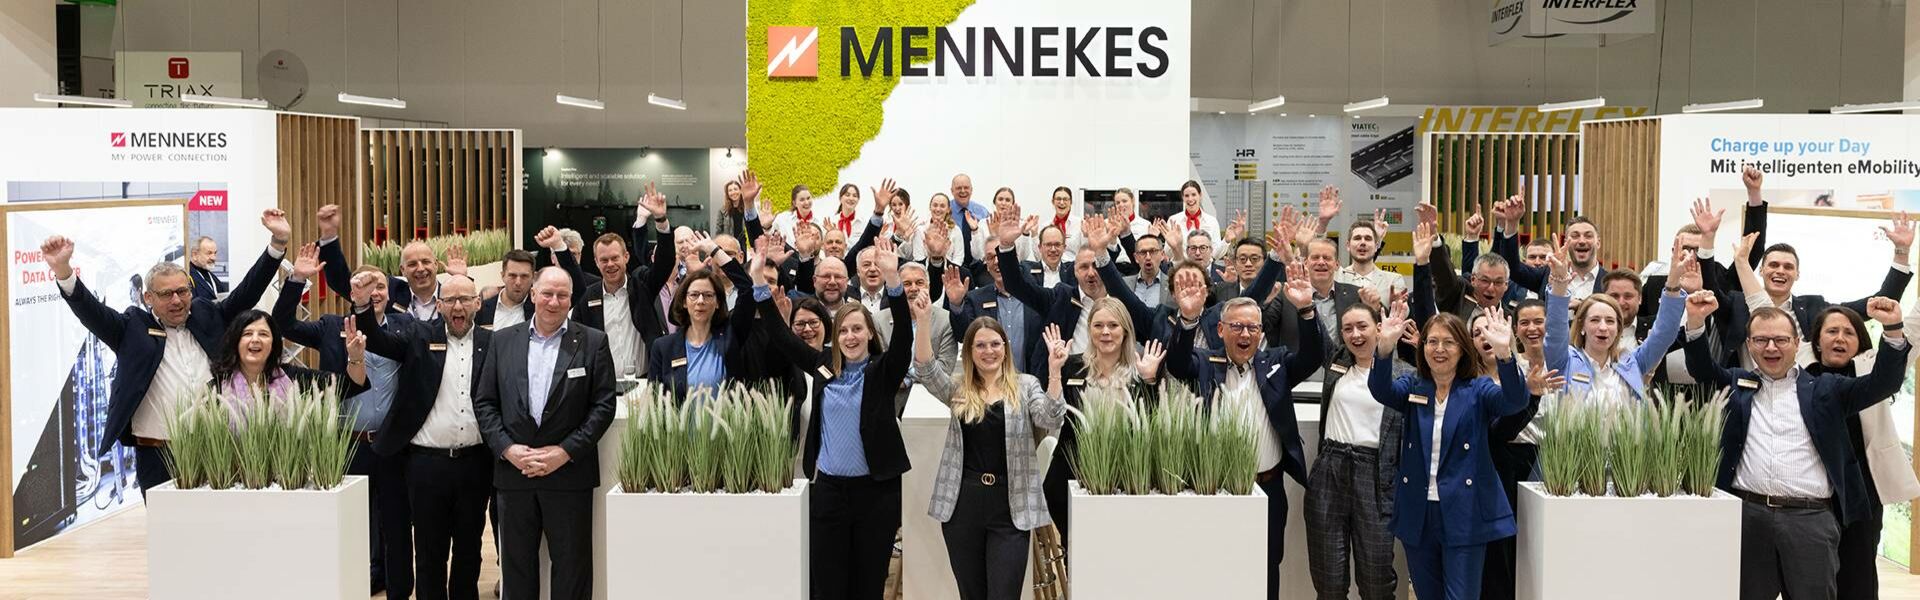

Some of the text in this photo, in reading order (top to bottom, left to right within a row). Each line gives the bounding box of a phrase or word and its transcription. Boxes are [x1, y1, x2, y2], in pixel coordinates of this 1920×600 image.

[840, 26, 1169, 78] MENNEKES
[143, 84, 214, 98] TRIAX
[130, 132, 228, 149] MENNEKES
[1711, 138, 1871, 156] Charge up your Day
[111, 153, 228, 162] MY POWER CONNECTION
[1236, 149, 1256, 157] HR
[1711, 159, 1736, 173] Mit
[199, 195, 223, 207] NEW
[22, 270, 46, 284] DATA
[15, 296, 37, 306] ALWAYS
[37, 294, 48, 303] THE
